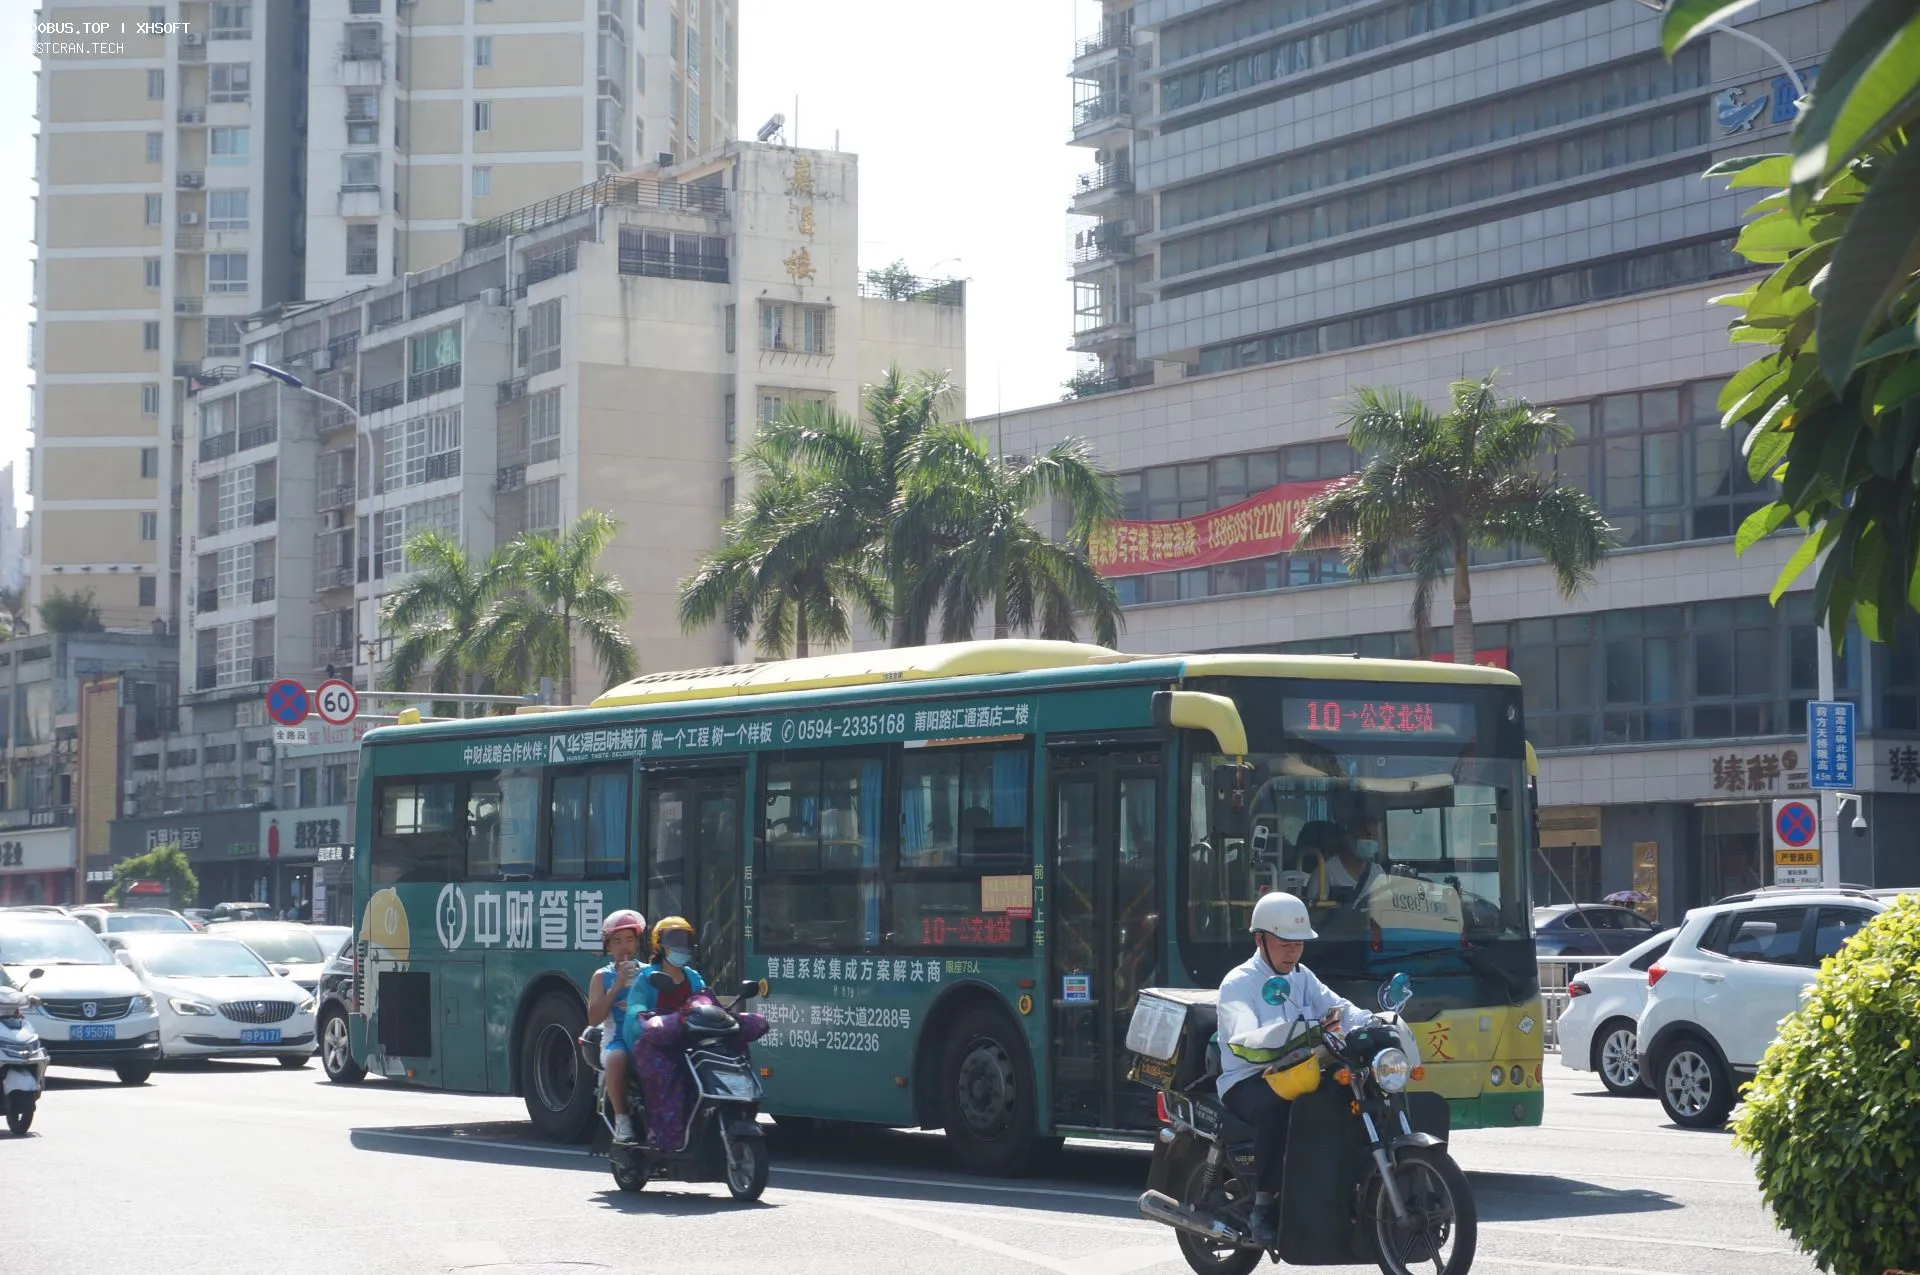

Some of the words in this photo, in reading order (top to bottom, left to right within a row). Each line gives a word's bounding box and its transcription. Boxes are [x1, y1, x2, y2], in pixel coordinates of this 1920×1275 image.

[325, 692, 349, 713] 60
[1307, 701, 1341, 731] 10
[1361, 703, 1433, 732] 公交北站
[276, 730, 306, 740] 全路段
[463, 741, 547, 766] 中财战略合作伙伴：
[567, 727, 648, 754] 华浔品味装饰
[652, 727, 709, 750] 做一个工程
[712, 721, 772, 747] 树一个样板
[798, 713, 905, 740] 0594-2335168
[914, 703, 1029, 732] 莆阳路汇通酒店二楼
[1815, 706, 1829, 771] 前方天桥限高
[1835, 707, 1848, 781] 超高车辆此处调头
[474, 890, 603, 950] 中财管道
[744, 865, 753, 940] 后门下车
[1034, 864, 1045, 946] 前门上车
[768, 956, 941, 983] 管道系统集成方案解决商
[1428, 1022, 1454, 1060] 交
